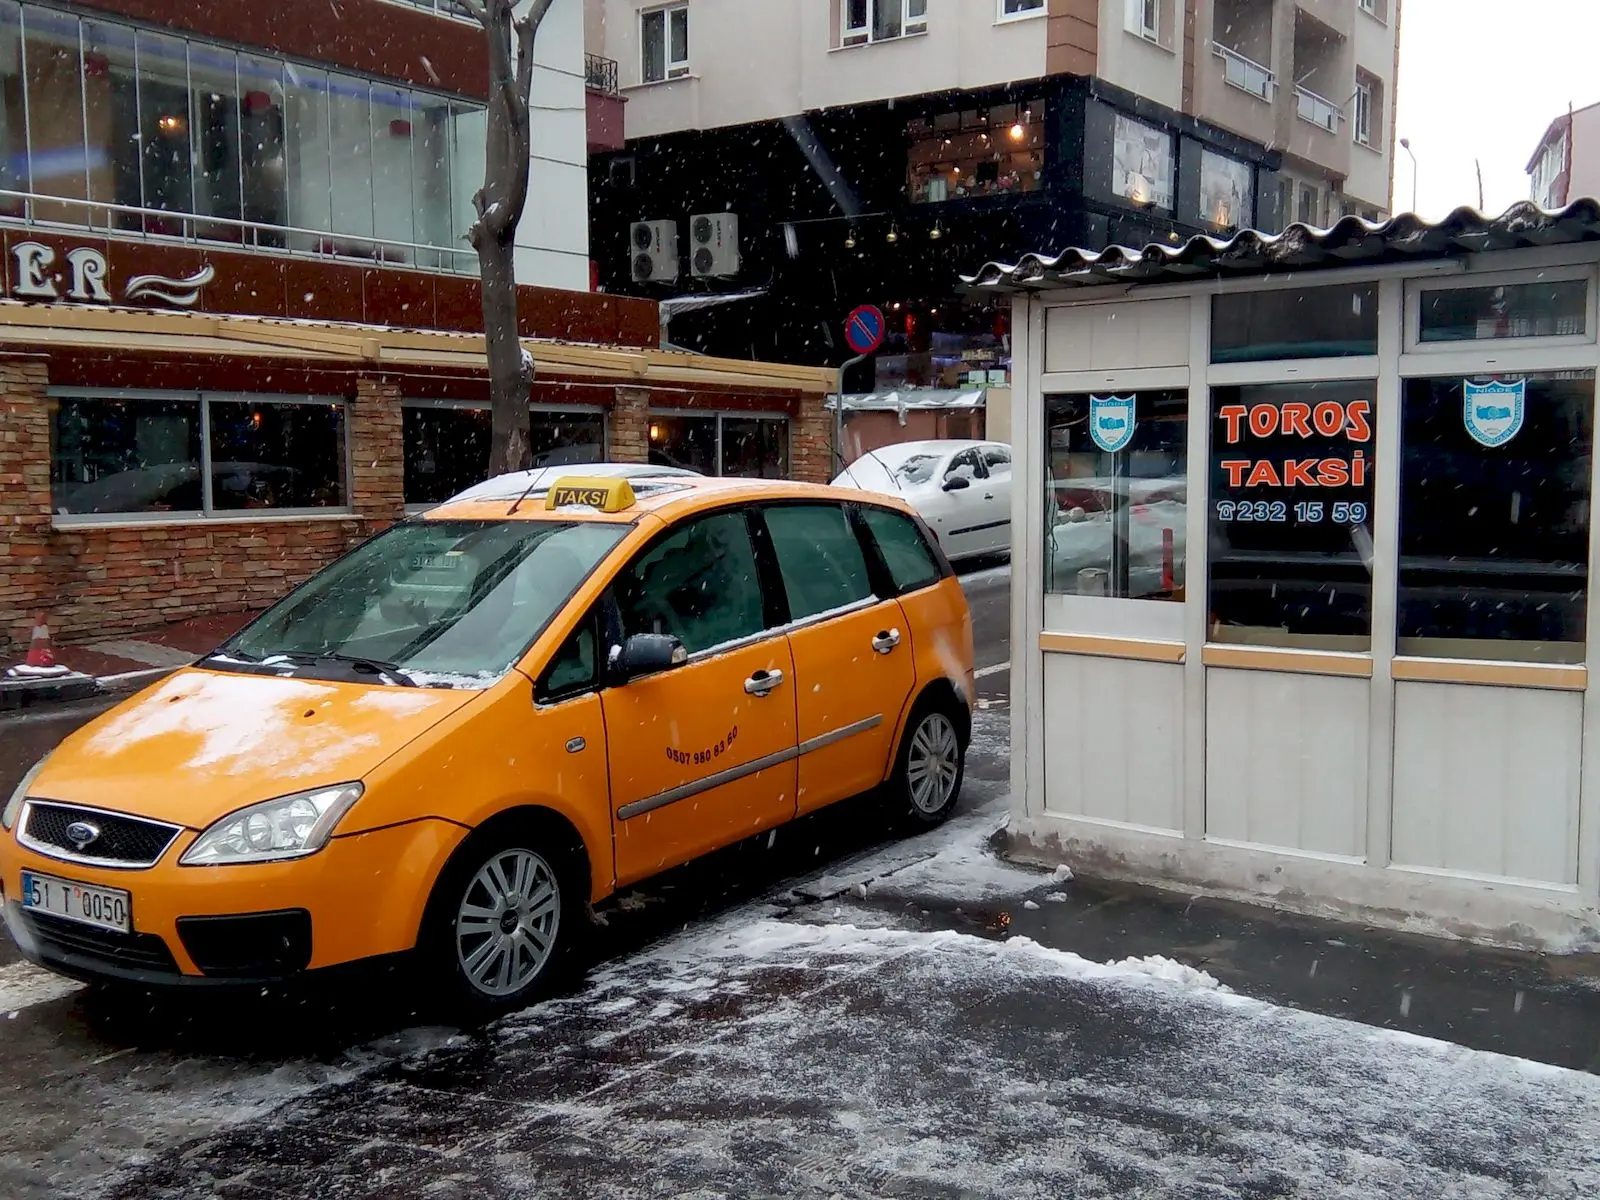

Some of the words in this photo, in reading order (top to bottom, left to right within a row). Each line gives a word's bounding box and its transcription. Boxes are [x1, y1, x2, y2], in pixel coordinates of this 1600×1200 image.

[0, 241, 112, 300] ER
[1219, 400, 1371, 444] TOROS
[1220, 450, 1366, 487] TAKSİ
[1237, 500, 1286, 521] 232
[1294, 502, 1323, 522] 15
[1331, 502, 1367, 523] 59
[666, 746, 691, 765] 0507
[713, 740, 725, 757] 83
[32, 880, 49, 908] 51
[62, 886, 70, 913] T
[83, 892, 124, 925] 0050
